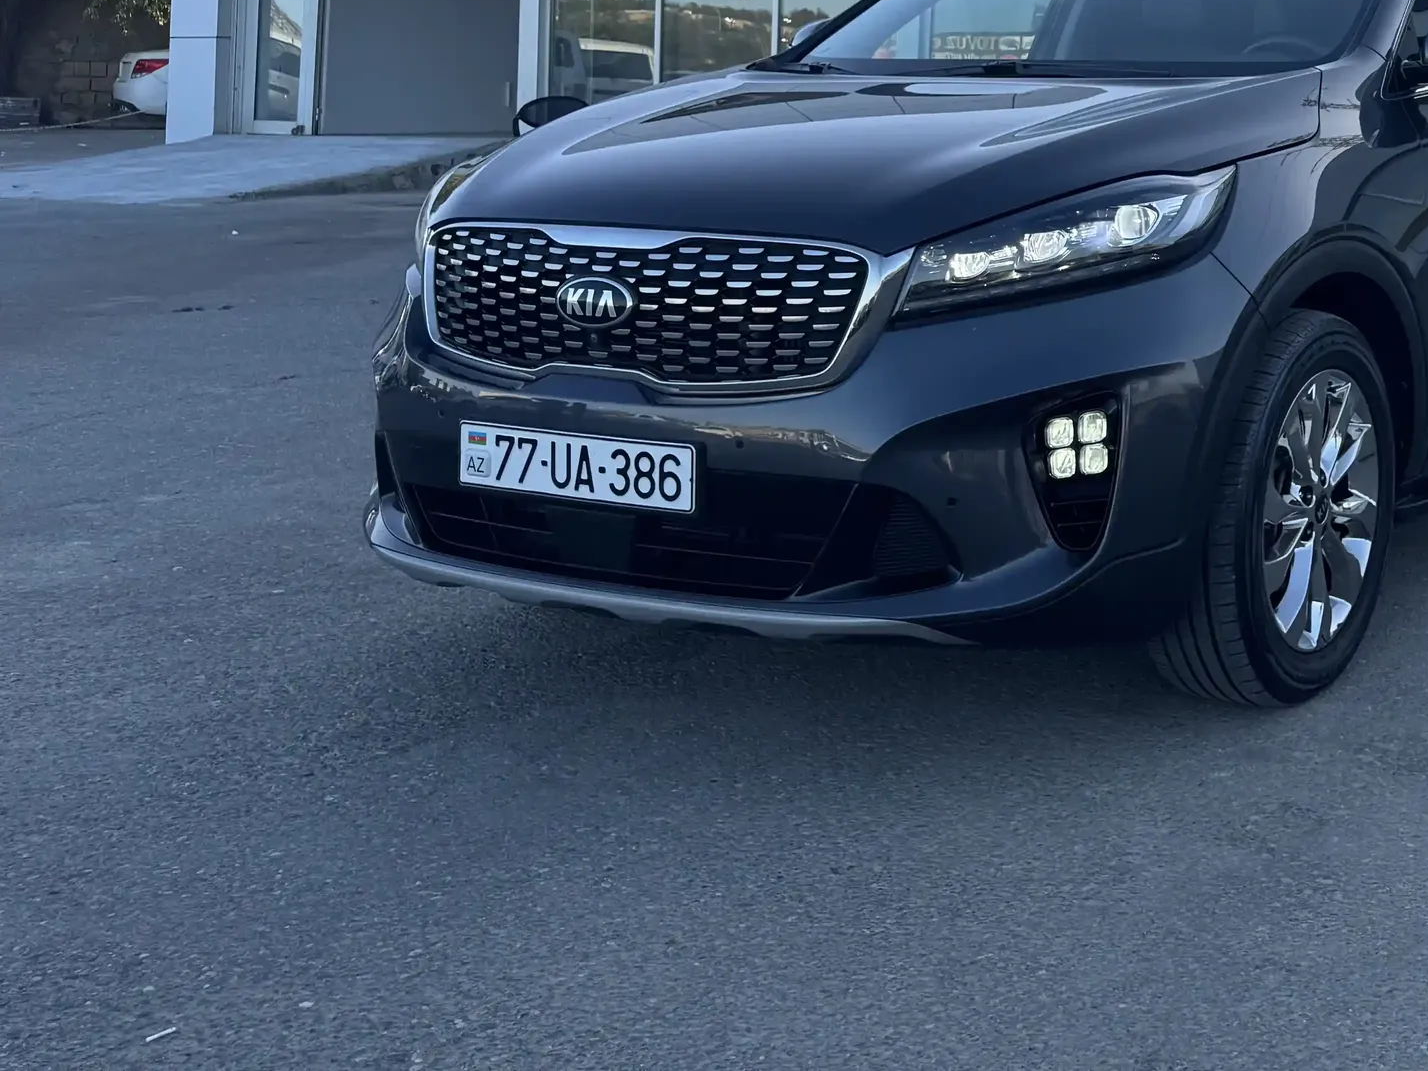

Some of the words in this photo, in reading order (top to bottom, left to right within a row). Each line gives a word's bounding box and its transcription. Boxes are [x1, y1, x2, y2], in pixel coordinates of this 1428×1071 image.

[566, 287, 617, 318] KIA
[466, 455, 485, 474] AZ
[495, 435, 682, 502] 77-UA-386
